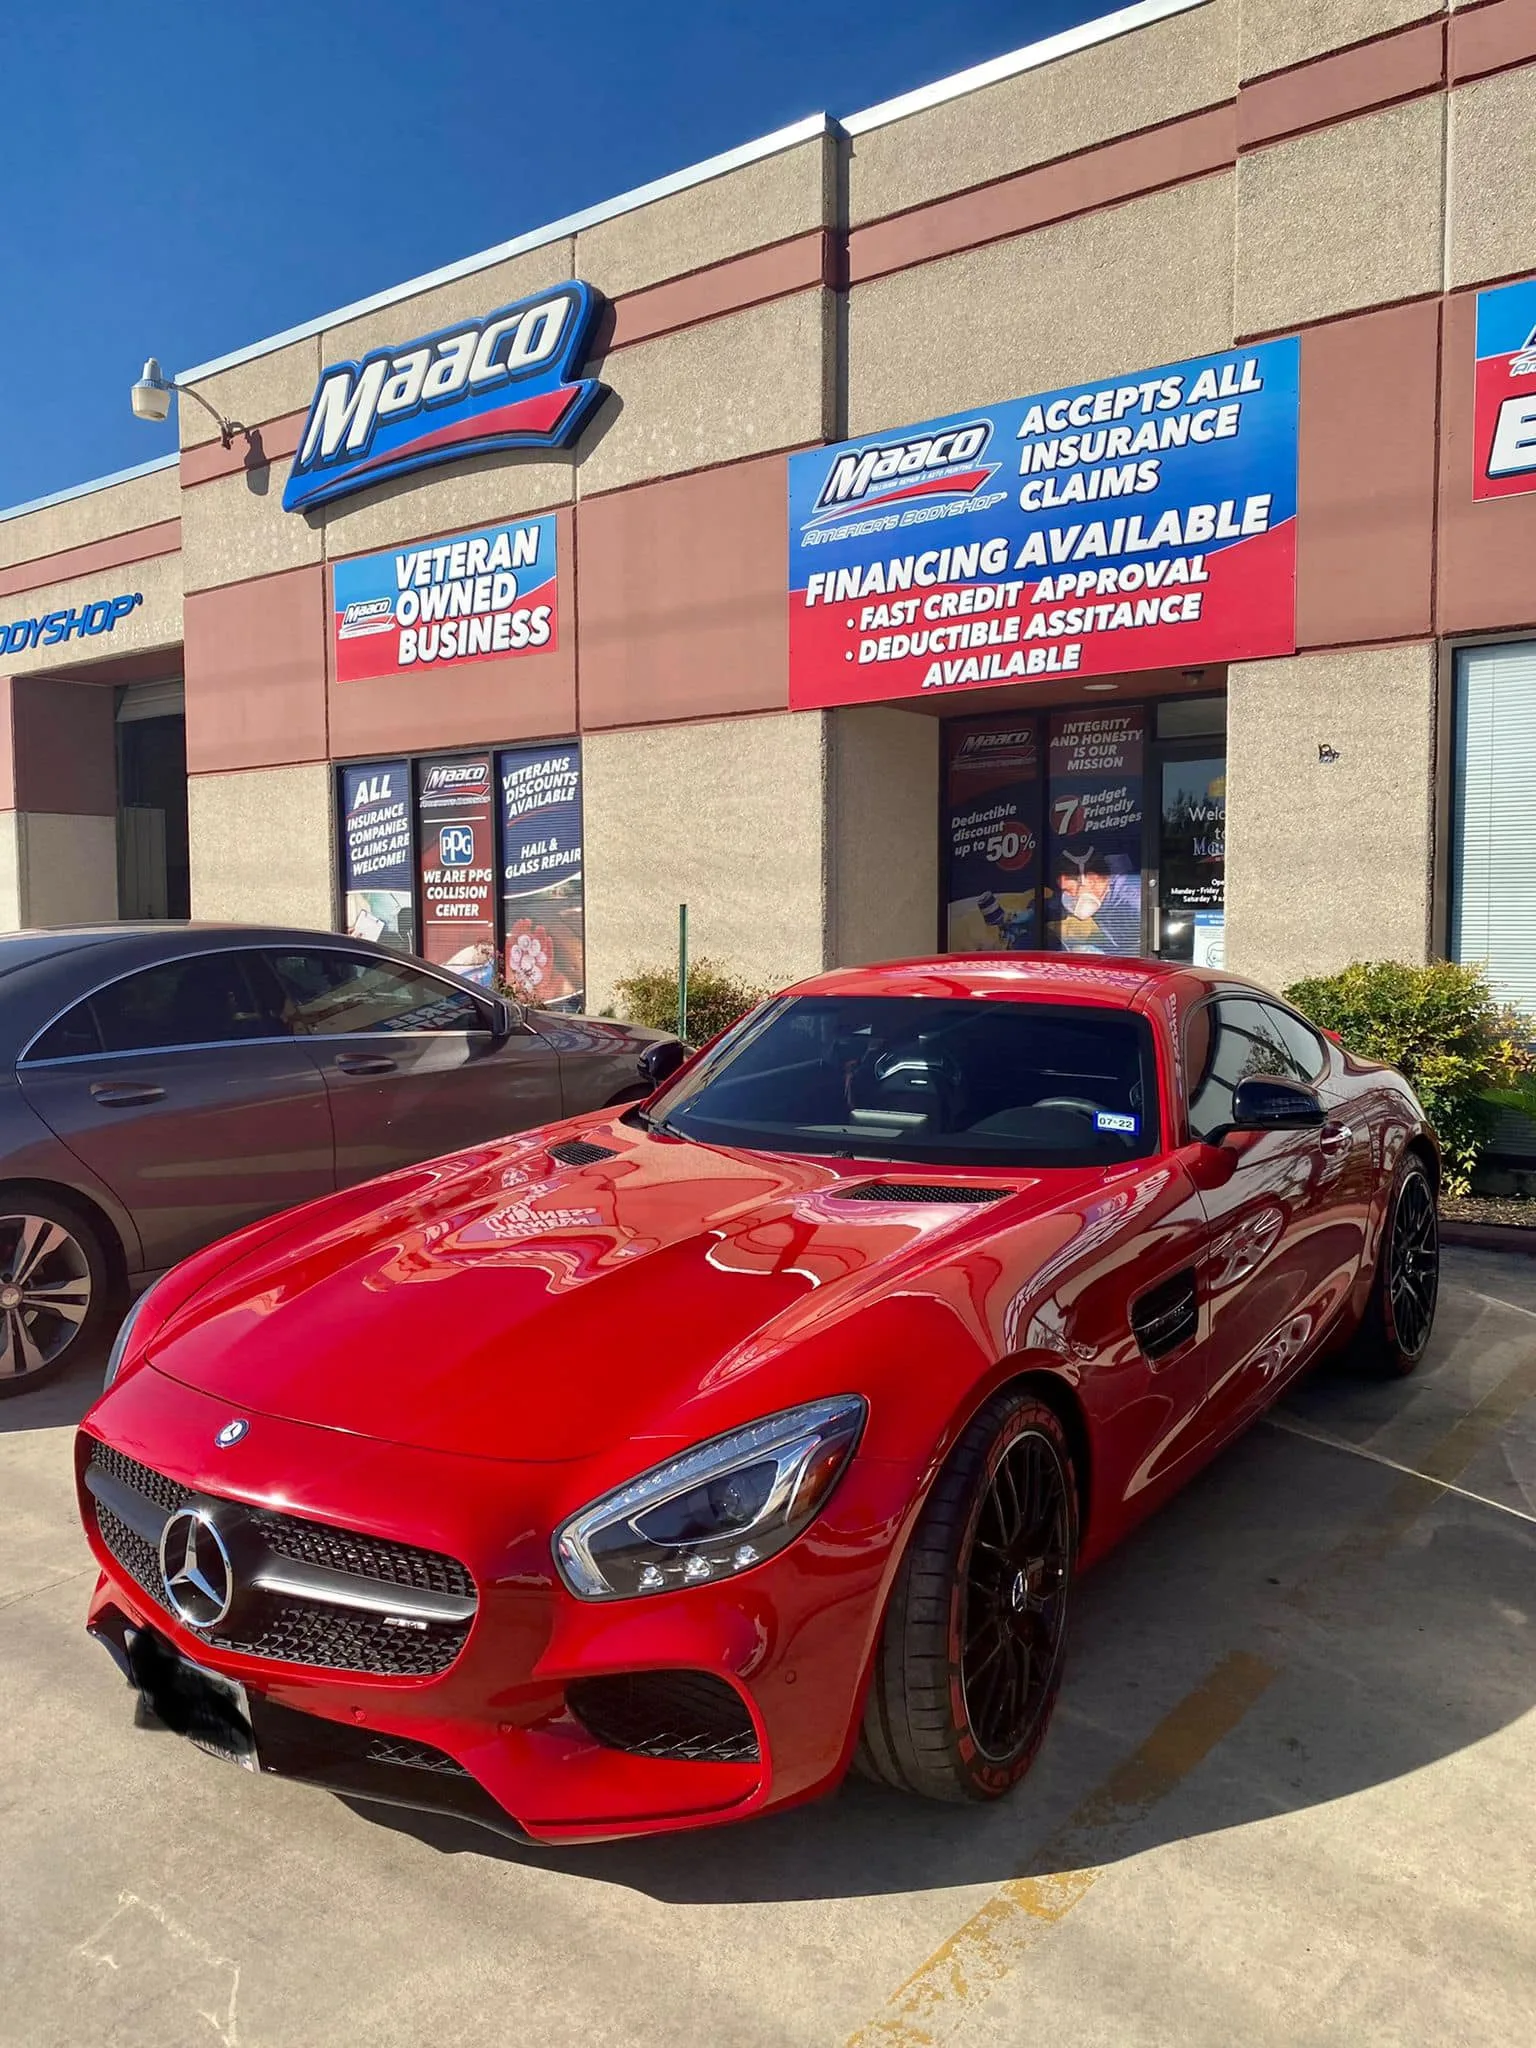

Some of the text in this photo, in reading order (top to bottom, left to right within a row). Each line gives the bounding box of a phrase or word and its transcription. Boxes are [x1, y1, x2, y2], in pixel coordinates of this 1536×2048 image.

[301, 296, 570, 465] Maaco
[1016, 359, 1264, 439] ACCEPTS ALL
[1018, 403, 1241, 476] INSURANCE
[823, 426, 988, 505] Maaco
[1019, 458, 1162, 512] CLAIMS
[395, 525, 541, 591] VETERAN
[805, 493, 1273, 607] FINANCING AVAILABLE
[395, 572, 518, 627] OWNED
[859, 554, 1210, 632] FAST CREDIT APPROVAL
[344, 600, 390, 625] Maaco
[398, 605, 552, 666] BUSINESS
[858, 592, 1203, 664] DEDUCTIBLE ASSITANCE
[922, 643, 1082, 689] AVAILABLE
[1050, 730, 1144, 748] AND HONESTY
[1062, 717, 1131, 734] INTEGRITY
[962, 731, 1030, 752] Maaco
[1073, 744, 1118, 758] IS OUR
[428, 766, 486, 789] Maaco
[502, 757, 571, 790] VETERANS
[1067, 756, 1124, 771] MISSION
[353, 774, 392, 809] ALL
[506, 771, 579, 805] DISCOUNTS
[508, 787, 576, 819] AVAILABLE
[1081, 786, 1128, 808] Budget
[347, 802, 404, 832] INSURANCE
[951, 803, 1017, 829] Deductible
[1055, 799, 1079, 835] 7
[1083, 799, 1135, 819] Friendly
[1084, 811, 1142, 832] Packages
[349, 817, 408, 846] COMPANIES
[351, 832, 410, 861] CLAIMS ARE
[953, 820, 1005, 843] discount
[520, 837, 559, 860] HAIL &
[954, 832, 1036, 862] up to 50%
[353, 849, 406, 876] WELCOME!
[424, 868, 492, 884] WE ARE PPG
[505, 847, 582, 879] GLASS REPAIR
[427, 885, 488, 900] COLLISION
[435, 903, 480, 917] CENTER
